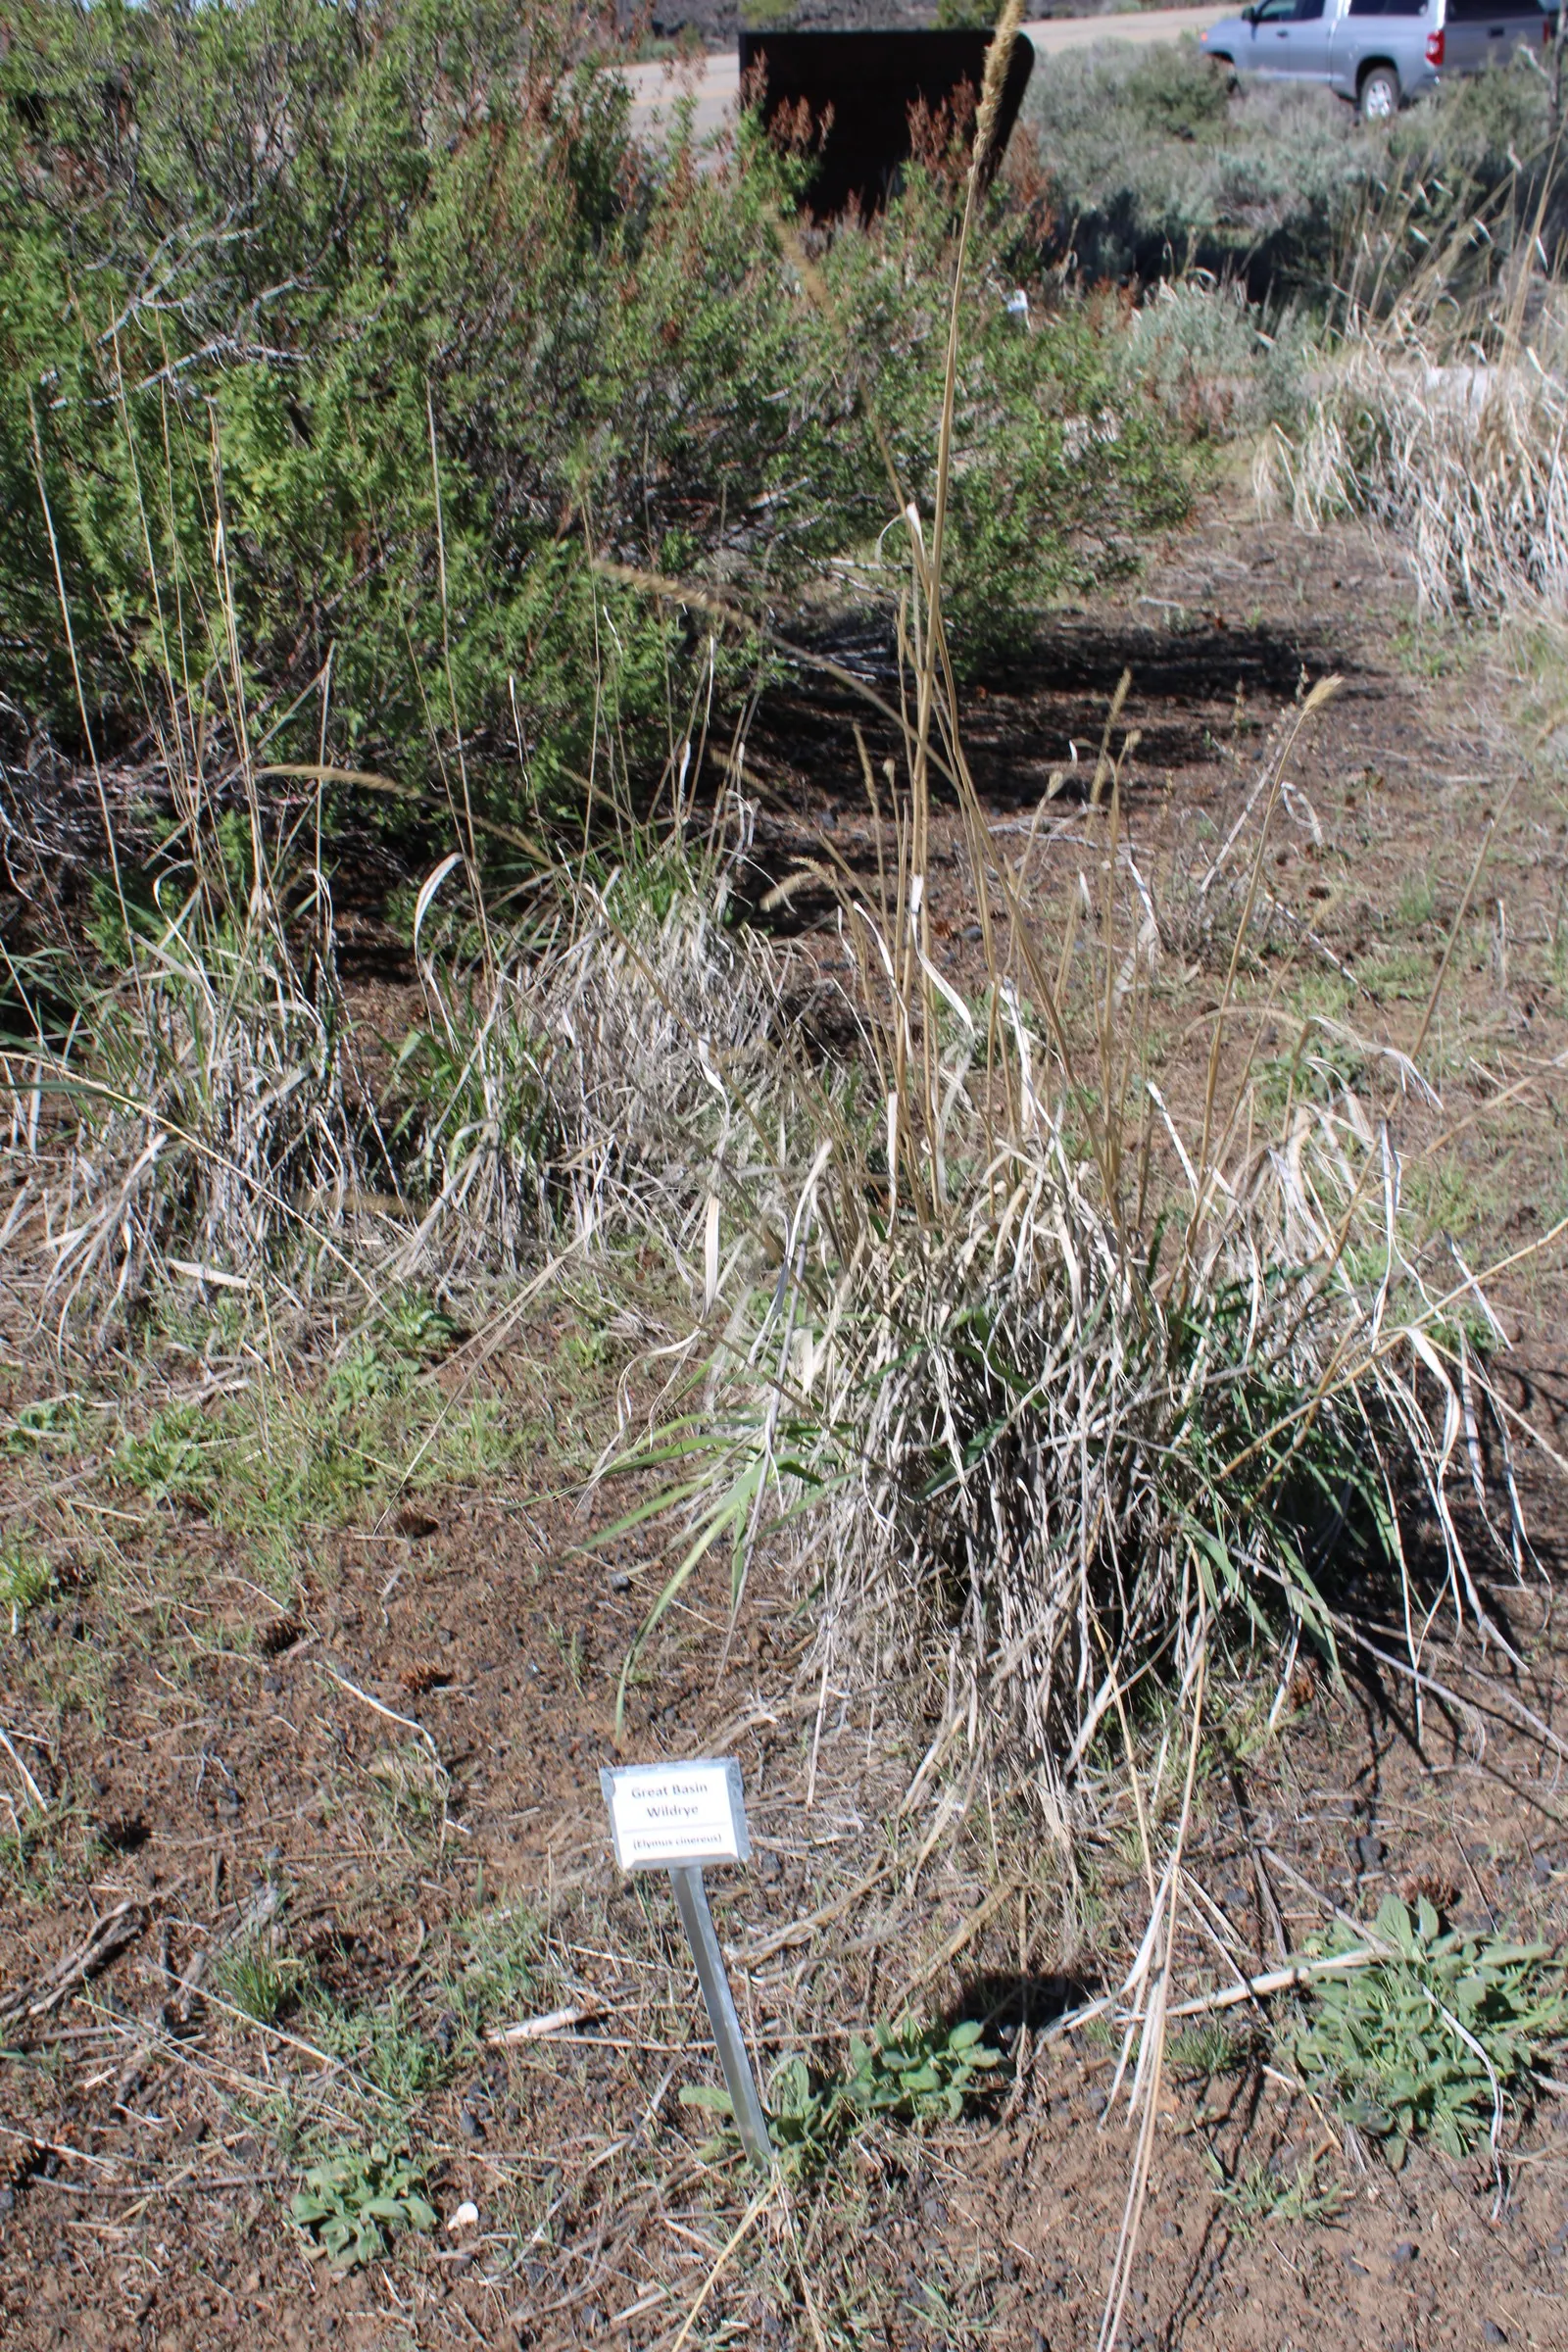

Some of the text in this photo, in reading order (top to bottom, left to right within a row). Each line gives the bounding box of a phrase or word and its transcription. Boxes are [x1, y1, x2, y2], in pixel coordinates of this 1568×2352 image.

[631, 1782, 708, 1799] Great Basin
[646, 1805, 699, 1818] Wildrye
[633, 1833, 722, 1850] (Elymus cinereus)
